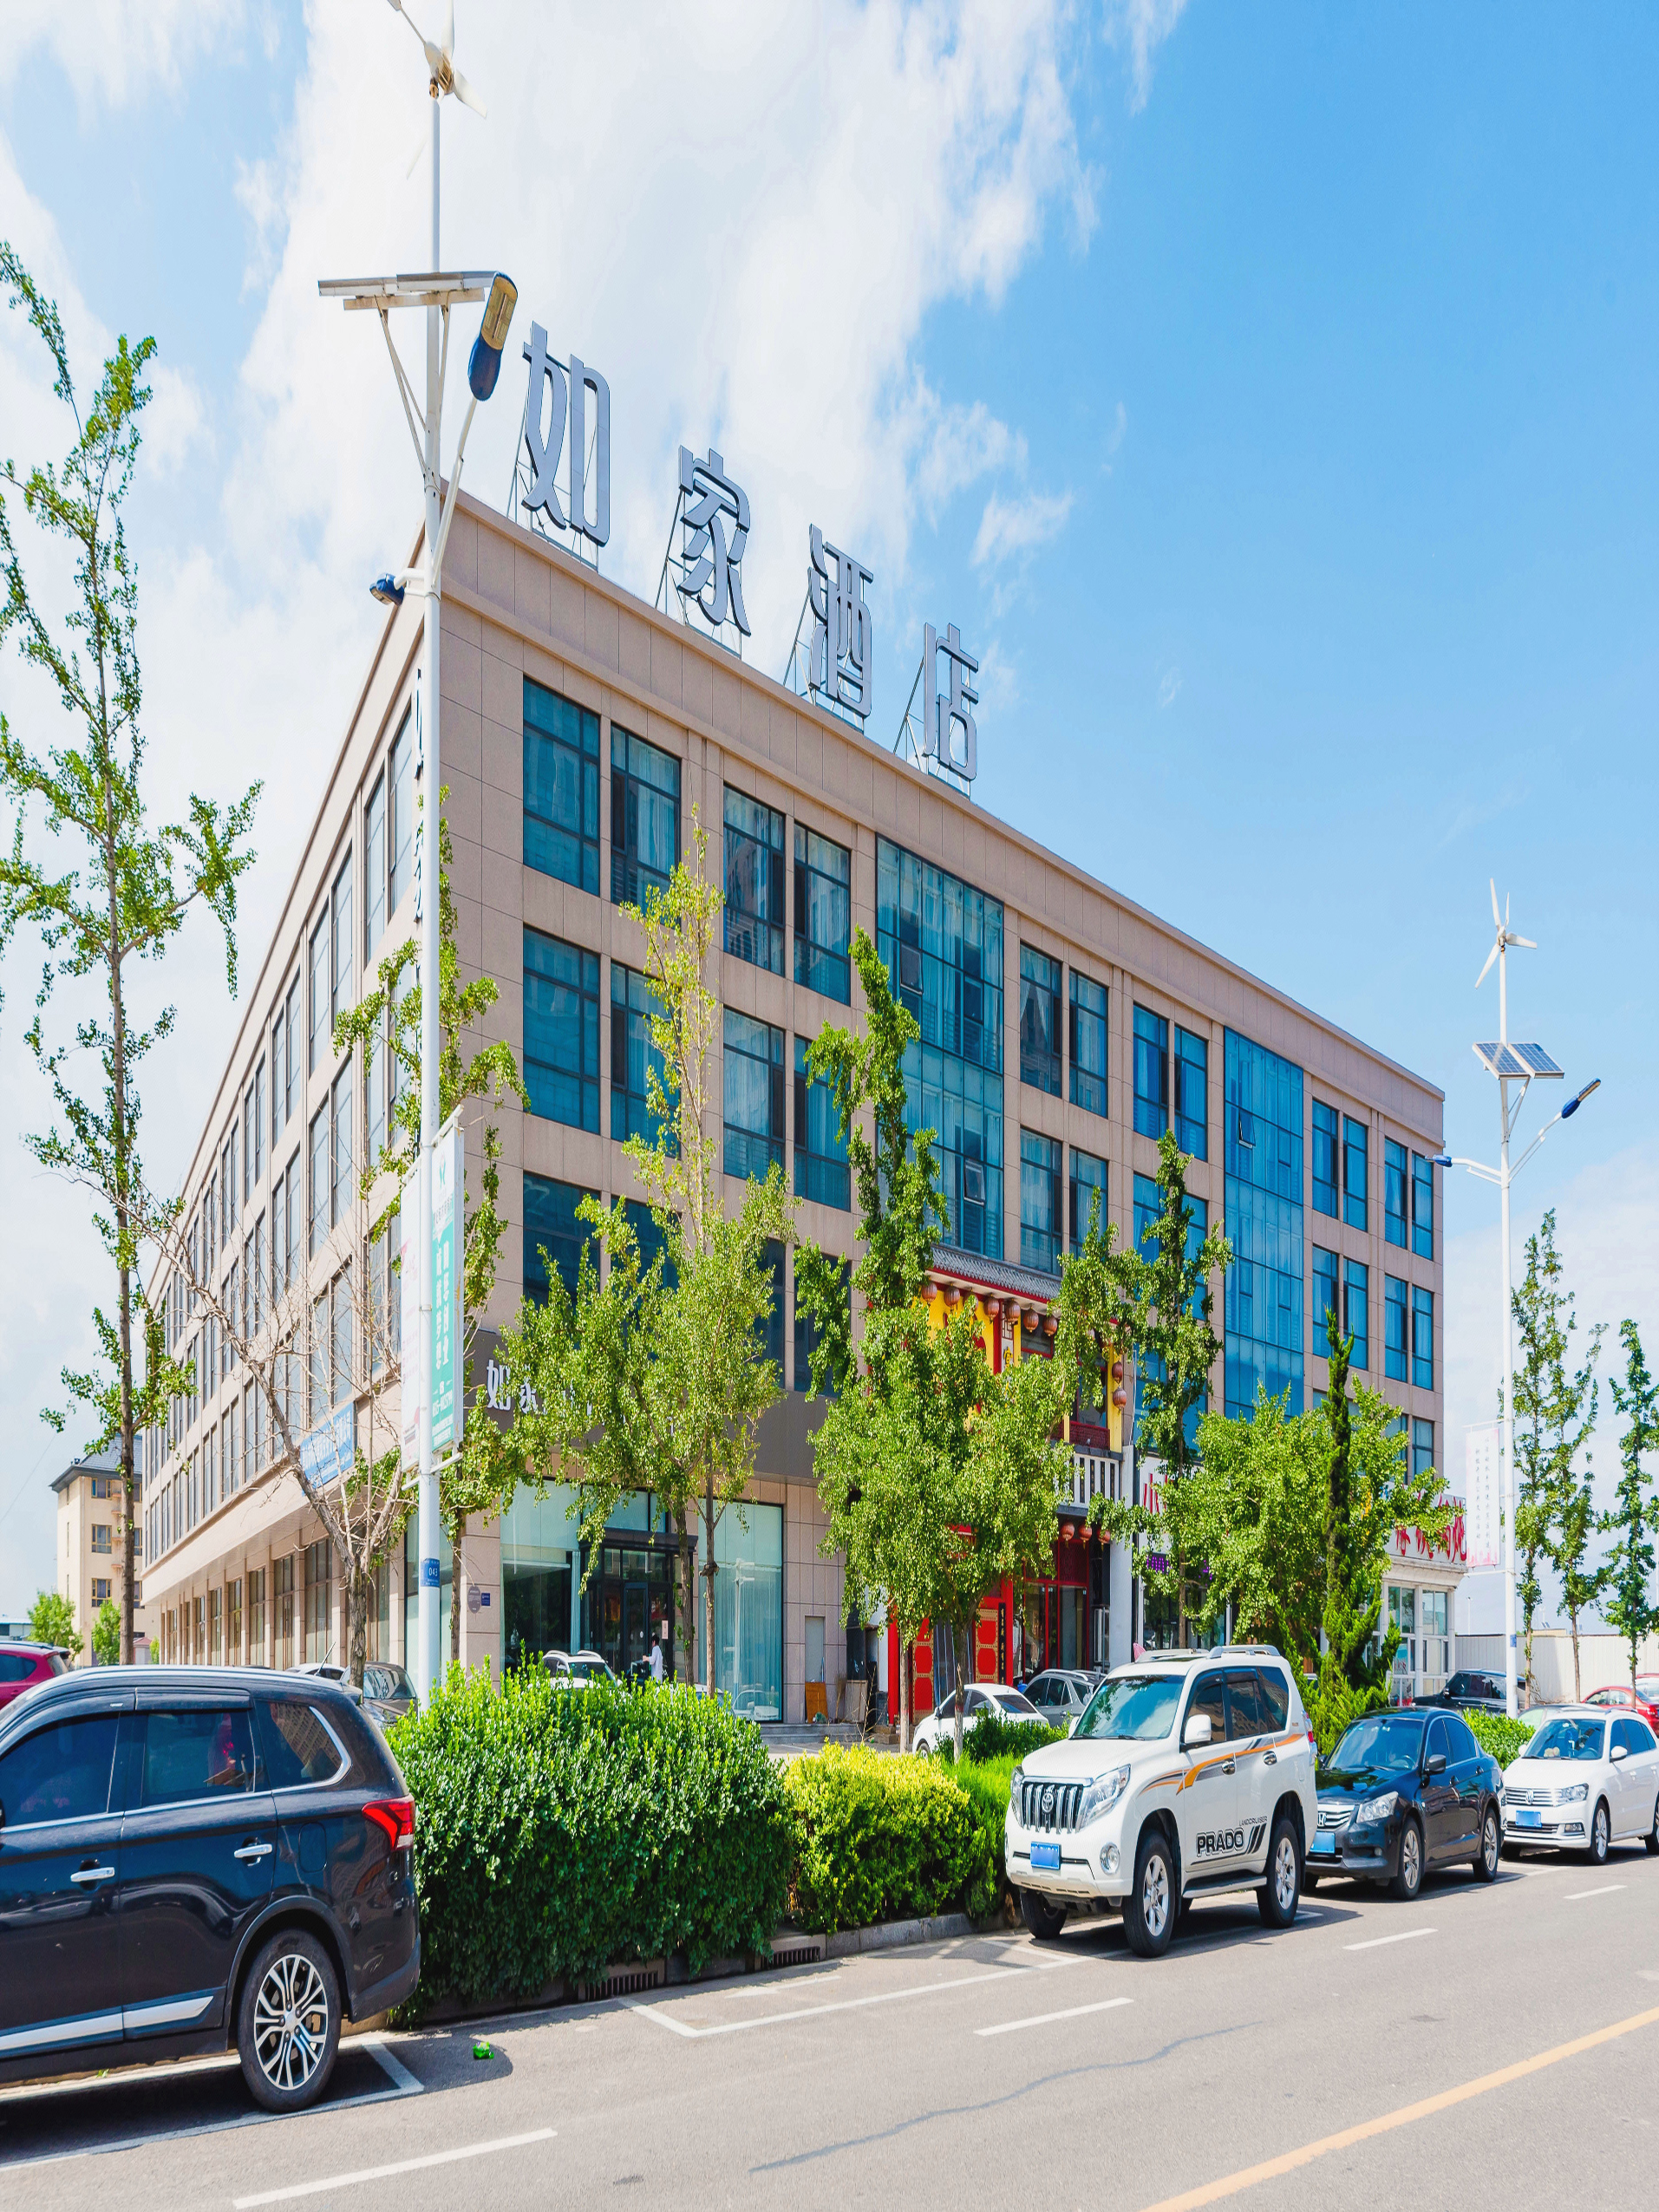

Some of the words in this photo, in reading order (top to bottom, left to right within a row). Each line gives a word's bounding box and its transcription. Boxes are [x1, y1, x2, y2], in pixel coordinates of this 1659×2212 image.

[522, 321, 979, 782] 如家酒店
[1196, 1827, 1244, 1857] PRADO
